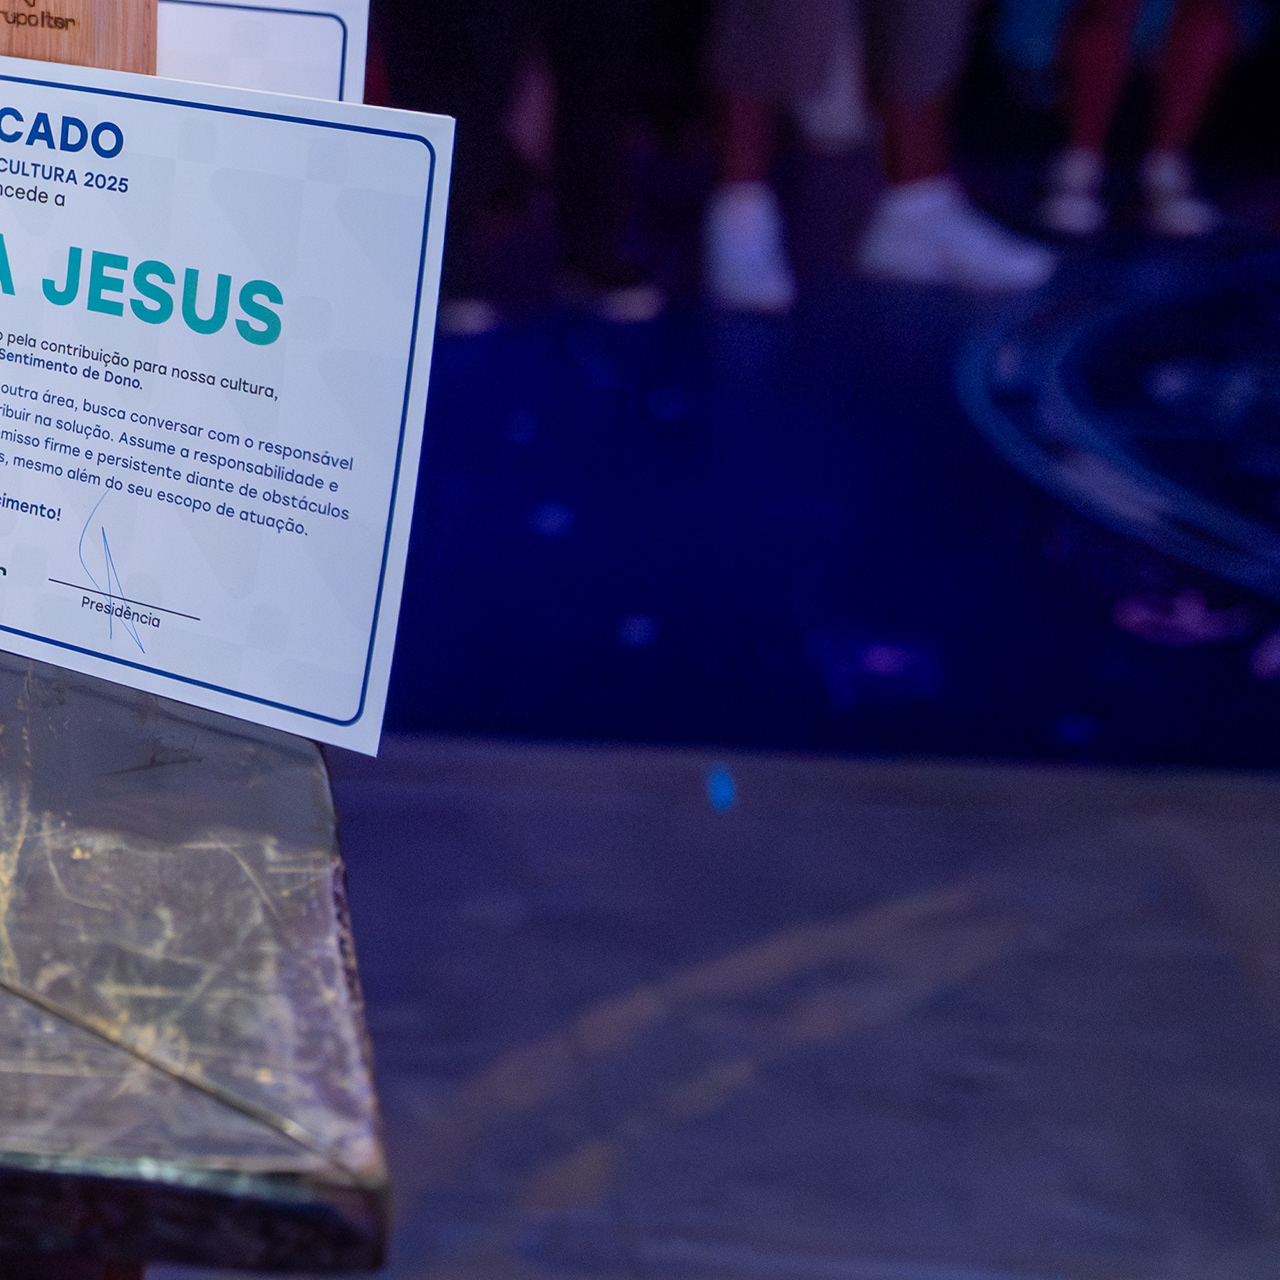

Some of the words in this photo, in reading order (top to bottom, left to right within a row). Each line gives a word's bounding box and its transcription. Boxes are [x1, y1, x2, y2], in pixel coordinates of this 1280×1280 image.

[54, 193, 66, 207] a
[83, 171, 129, 194] 2025
[41, 246, 284, 346] JESUS
[6, 333, 37, 348] pela
[40, 340, 130, 368] contribuição
[133, 359, 168, 376] para
[171, 367, 216, 386] nossa
[220, 377, 278, 402] cultura,
[82, 365, 100, 380] de
[104, 370, 147, 391] Dono.
[0, 383, 39, 401] outra
[42, 389, 78, 412] área,
[82, 398, 126, 420] busca
[130, 412, 204, 437] conversar
[207, 429, 240, 446] com
[244, 437, 254, 449] o
[44, 436, 81, 457] firme
[84, 449, 94, 460] e
[96, 452, 182, 481] persistente
[186, 471, 234, 493] diante
[55, 419, 118, 443] solução.
[118, 431, 176, 456] Assume
[179, 447, 190, 459] a
[193, 450, 325, 489] responsabilidade
[13, 456, 64, 477] mesmo
[67, 467, 101, 486] além
[105, 475, 123, 491] do
[127, 483, 153, 498] seu
[156, 490, 212, 513] escopo
[81, 595, 161, 628] Presidência
